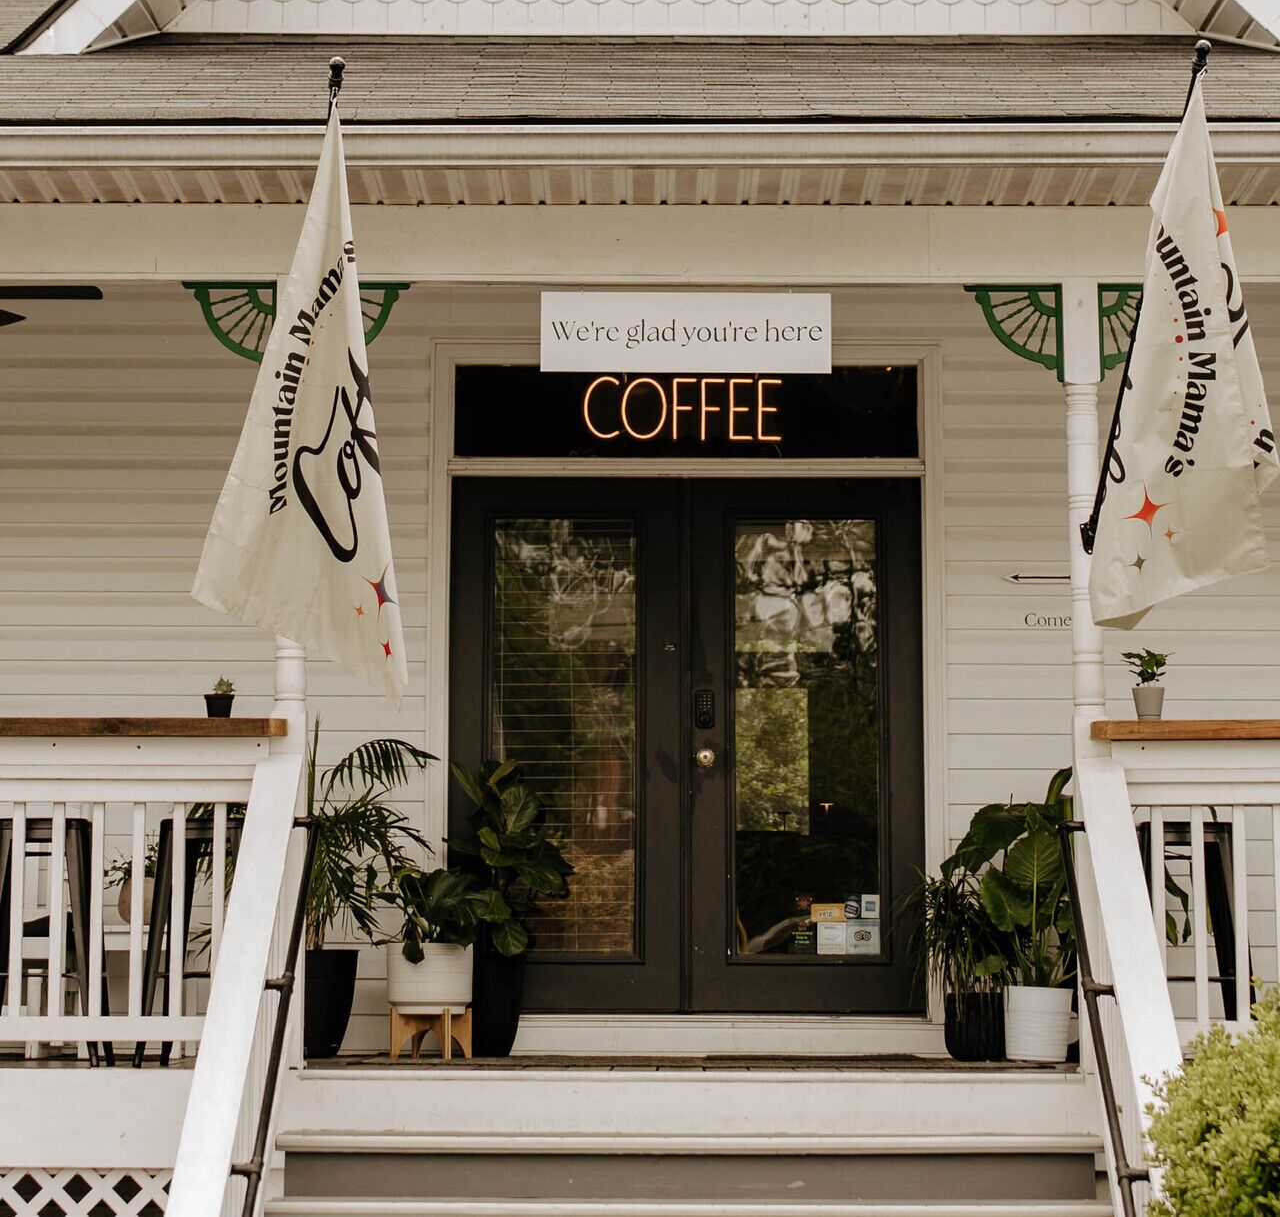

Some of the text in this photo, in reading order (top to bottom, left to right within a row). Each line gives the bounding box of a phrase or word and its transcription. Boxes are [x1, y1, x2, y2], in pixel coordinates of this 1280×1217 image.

[551, 319, 823, 348] We're glad you're here
[270, 352, 307, 516] Mountain
[583, 376, 782, 441] COFFEE
[1164, 351, 1217, 478] Mama's
[1024, 612, 1072, 627] Come
